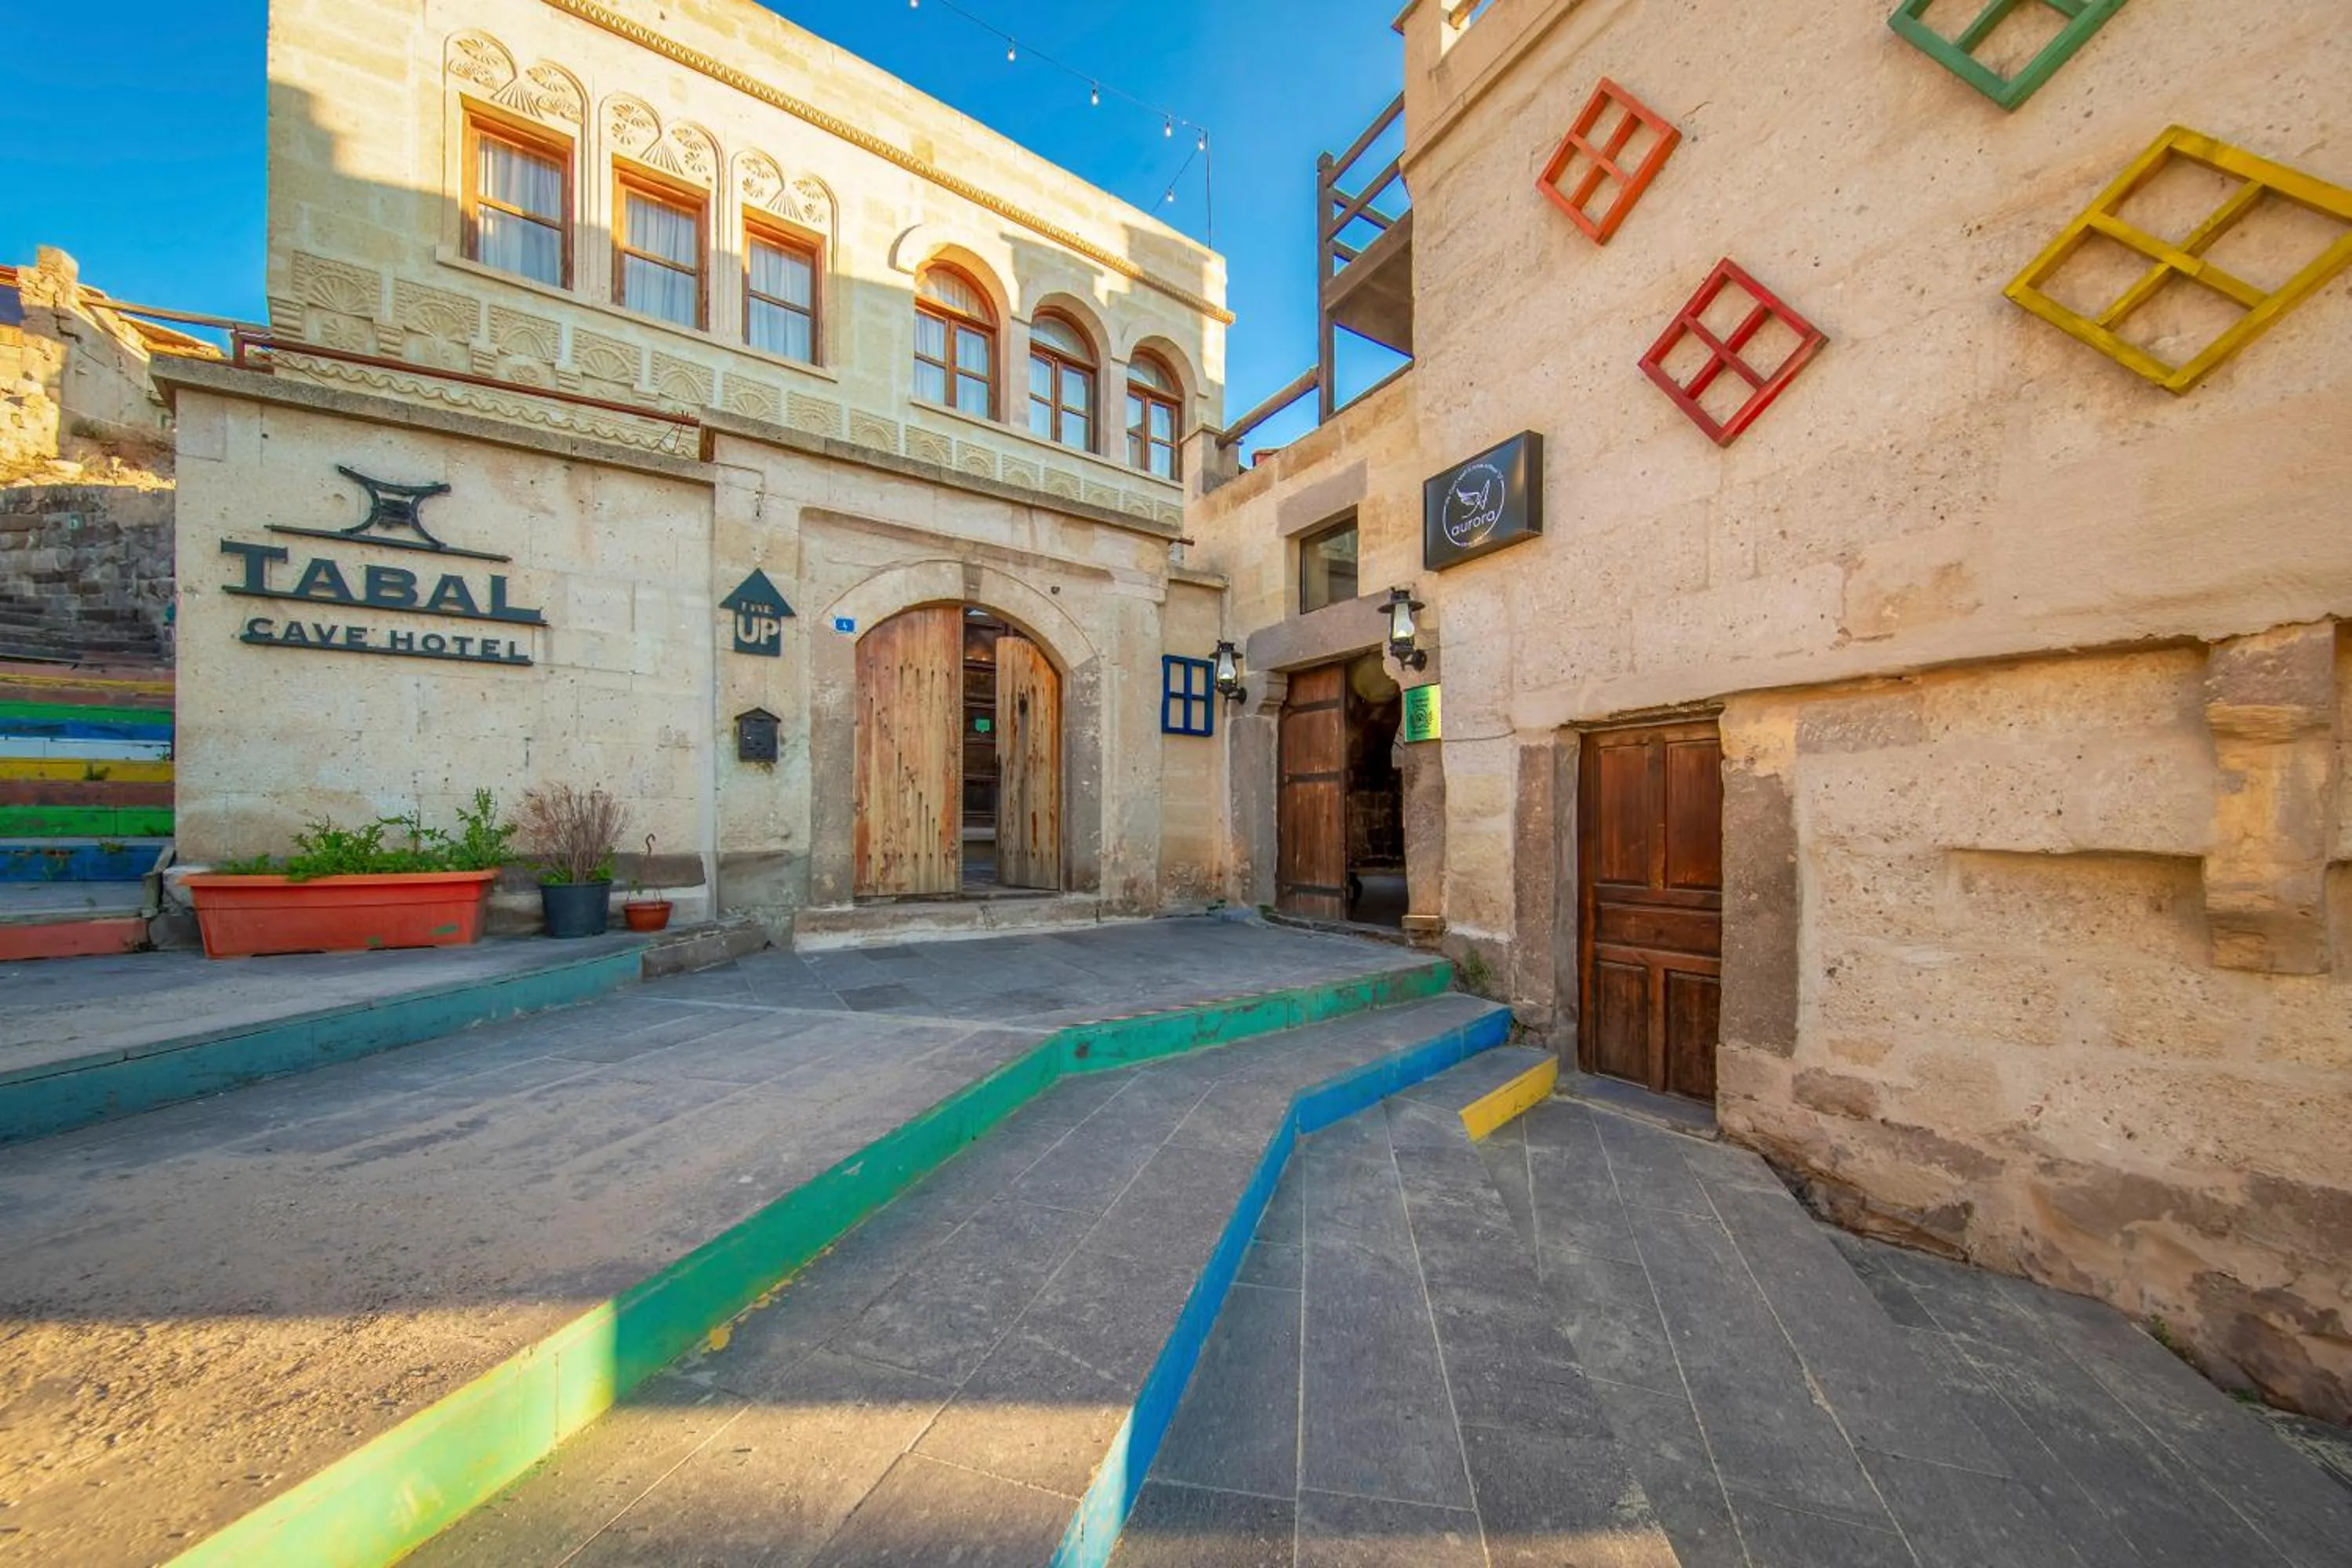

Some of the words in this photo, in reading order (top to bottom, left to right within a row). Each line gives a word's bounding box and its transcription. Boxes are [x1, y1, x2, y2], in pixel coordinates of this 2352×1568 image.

[220, 539, 543, 623] TABAL
[247, 617, 368, 647] CAVE
[390, 630, 530, 662] HOTEL
[737, 614, 780, 644] UP
